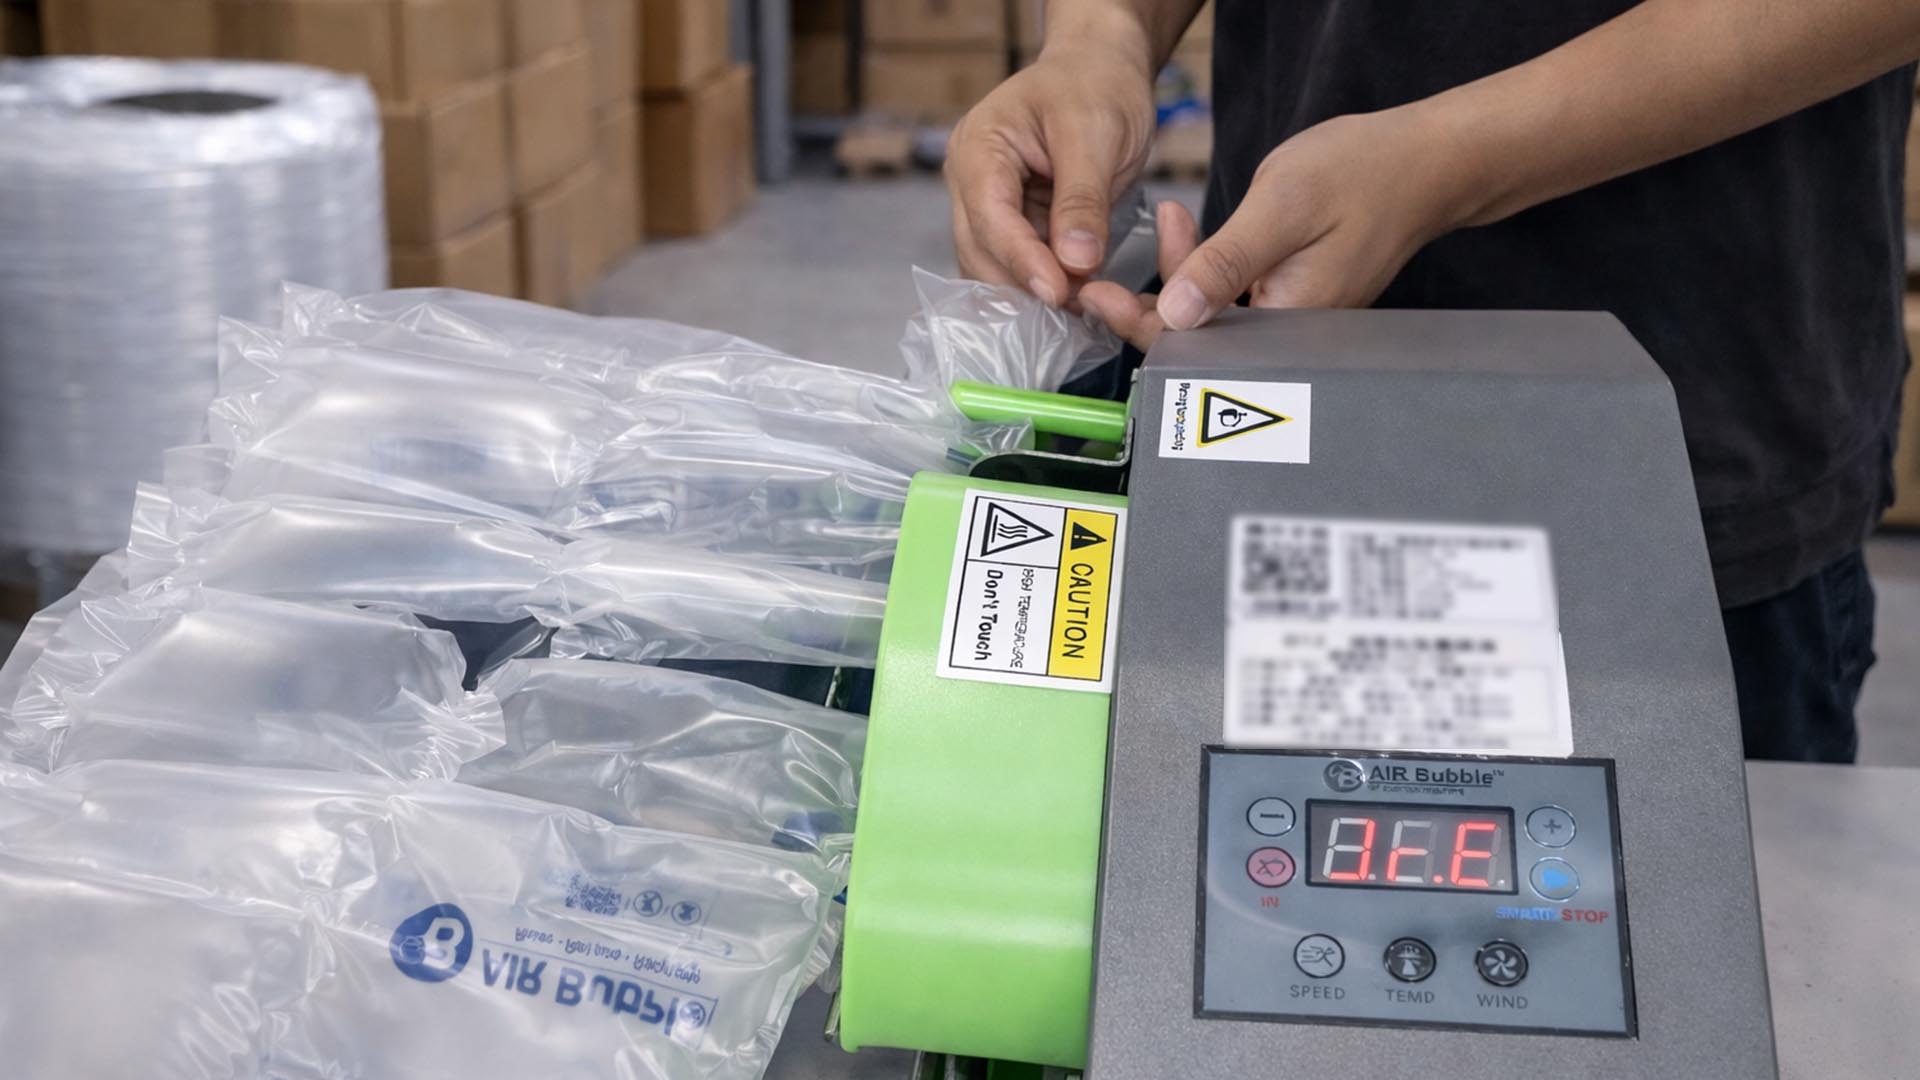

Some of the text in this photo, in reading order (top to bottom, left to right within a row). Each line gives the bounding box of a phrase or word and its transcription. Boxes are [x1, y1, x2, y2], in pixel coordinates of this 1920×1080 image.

[974, 569, 1003, 660] Don't Touch
[1062, 563, 1094, 658] CAUTION
[1369, 766, 1409, 781] AIR
[1415, 768, 1493, 784] Bubble
[1561, 908, 1609, 923] STOP
[1290, 984, 1346, 1000] SPEED
[1476, 994, 1529, 1009] WIND
